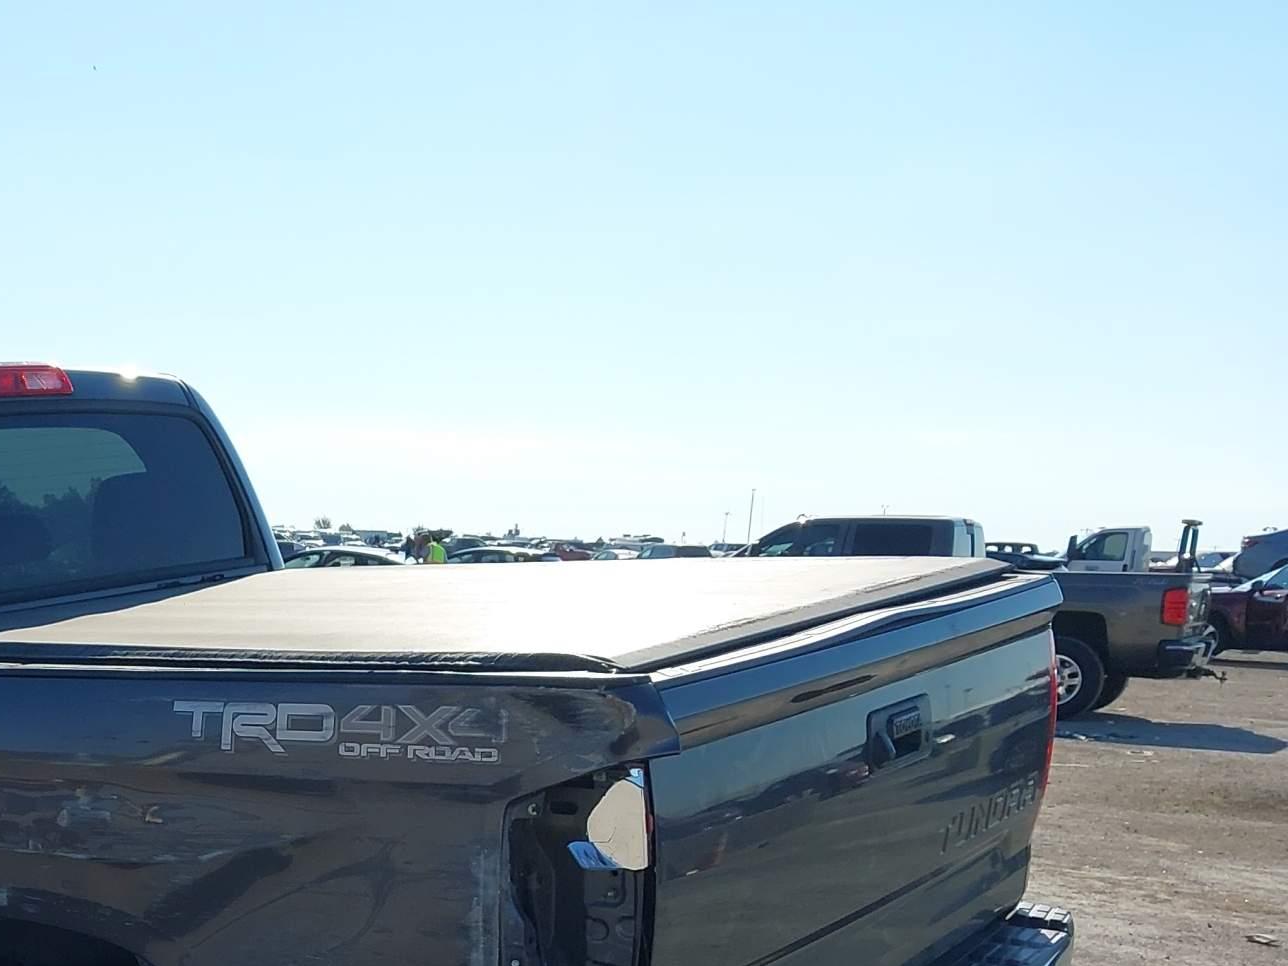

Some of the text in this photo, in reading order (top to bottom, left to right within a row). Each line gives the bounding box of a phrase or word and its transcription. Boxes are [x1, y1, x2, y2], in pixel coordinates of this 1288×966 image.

[173, 700, 338, 756] TRD
[338, 742, 500, 764] OFF ROAD
[938, 771, 1039, 856] TUNDRA
